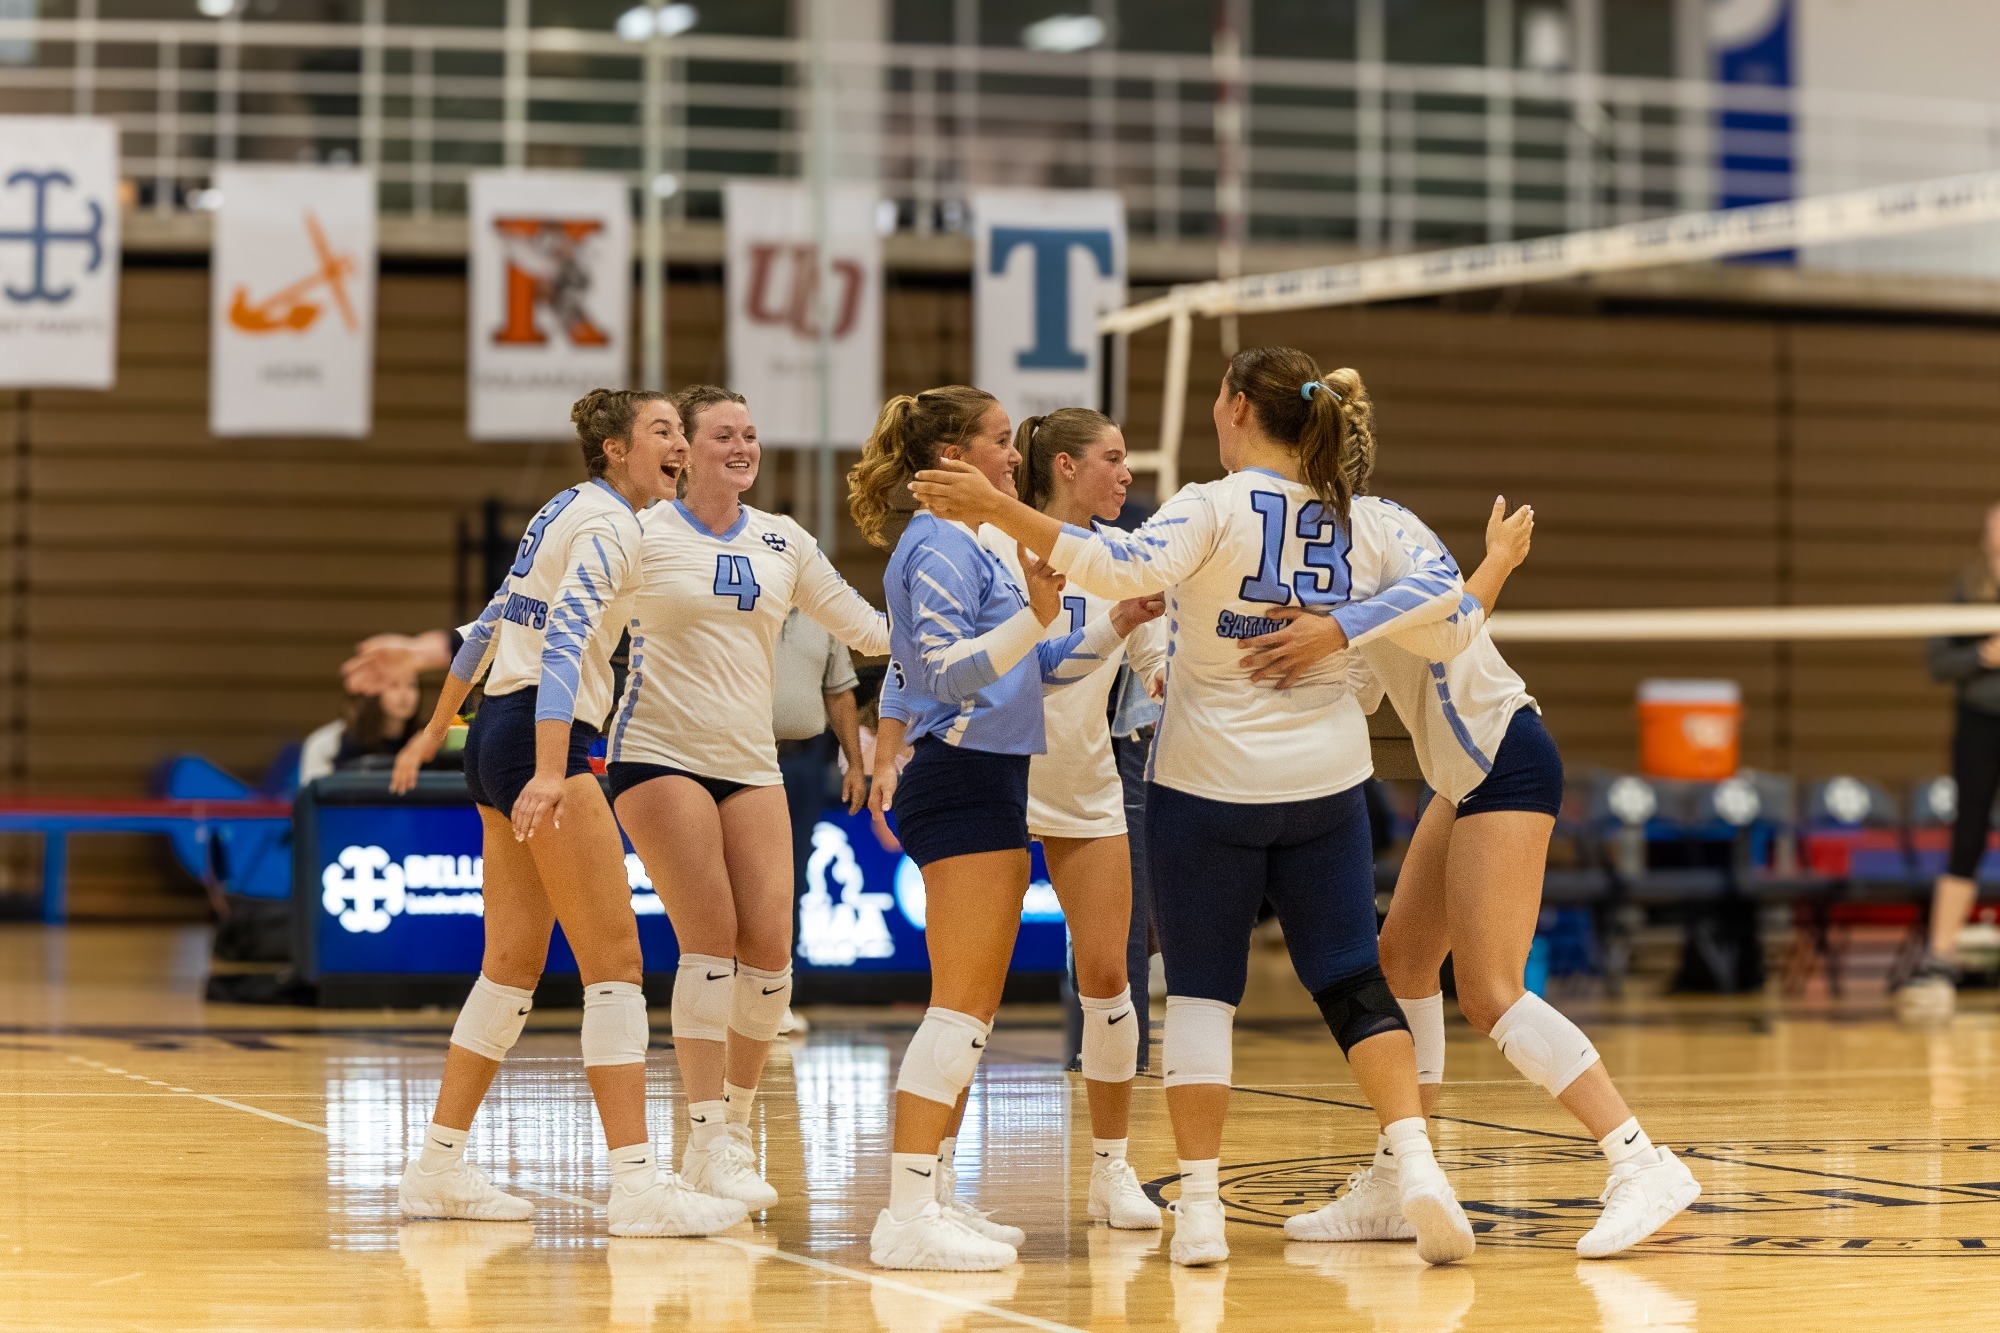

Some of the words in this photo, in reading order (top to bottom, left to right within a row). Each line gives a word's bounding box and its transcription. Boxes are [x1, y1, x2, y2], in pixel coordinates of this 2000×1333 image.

[989, 226, 1114, 371] T
[713, 554, 761, 611] 4
[1238, 489, 1352, 607] 13
